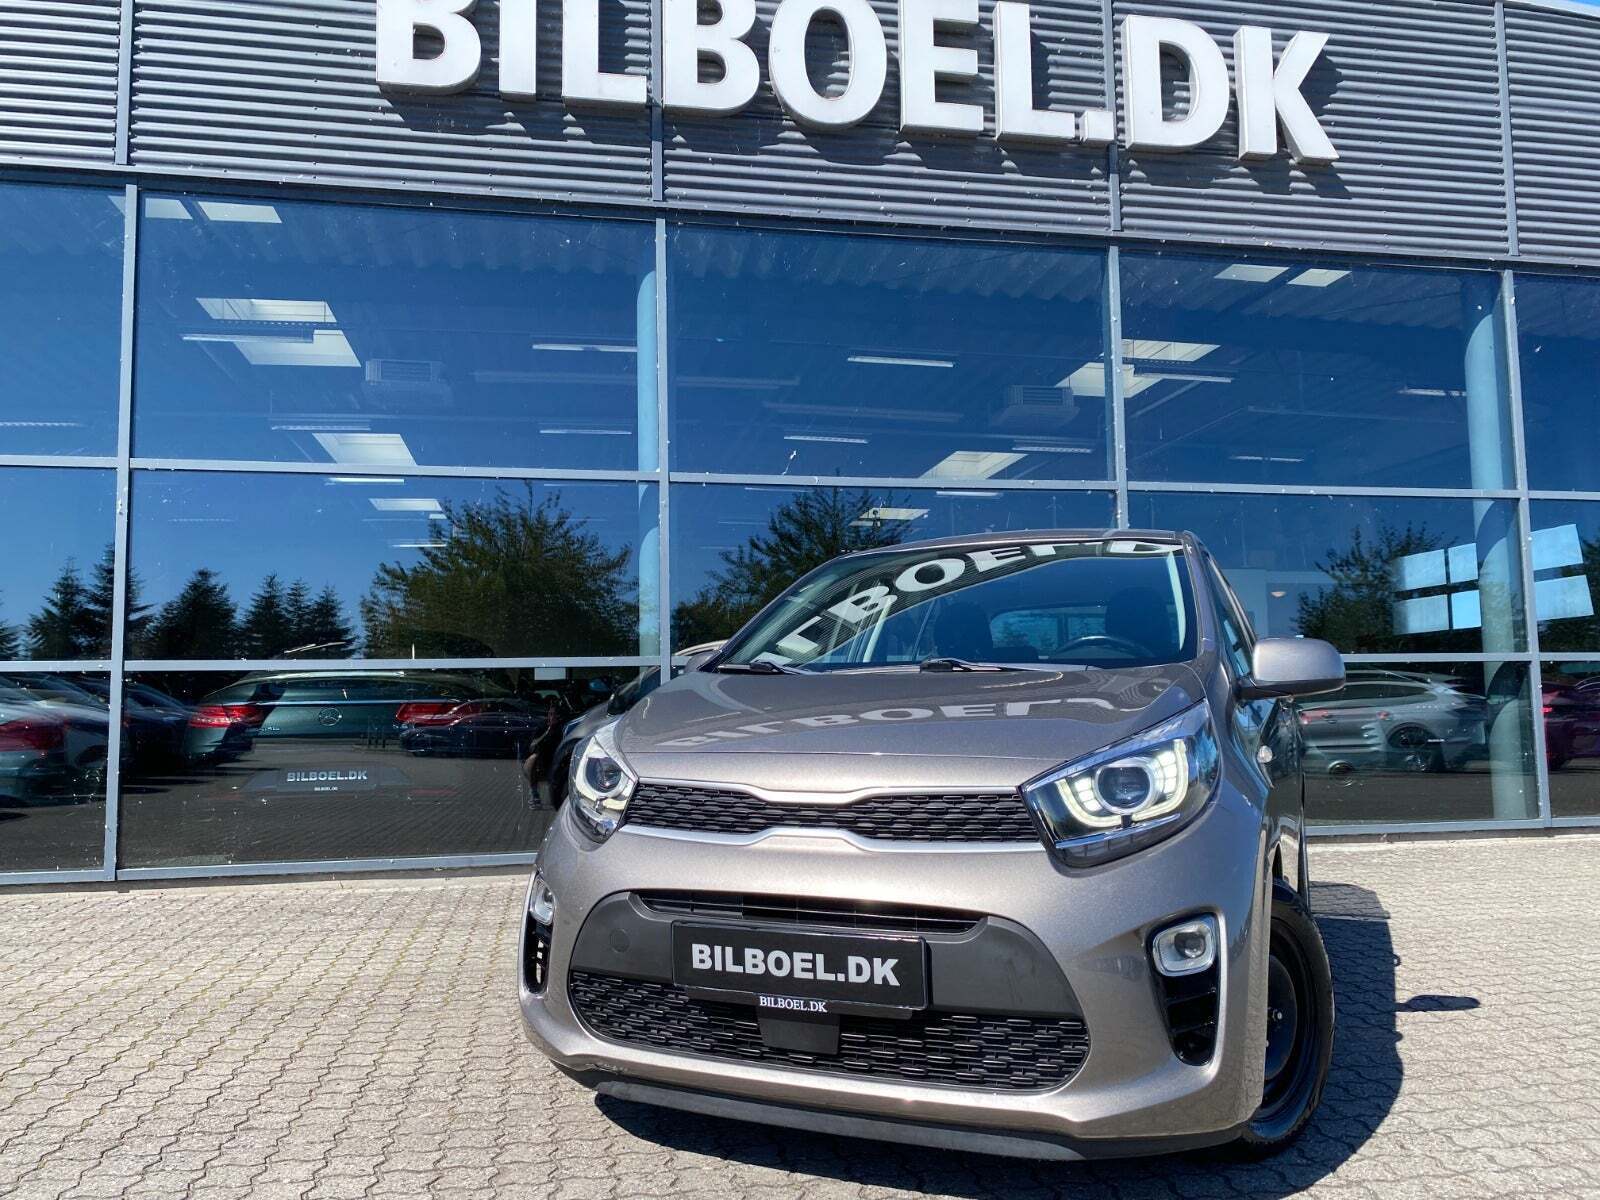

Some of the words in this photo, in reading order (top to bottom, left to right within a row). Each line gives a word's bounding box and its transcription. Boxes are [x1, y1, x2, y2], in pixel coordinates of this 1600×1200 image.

[375, 0, 1339, 163] BILBOEL.DK
[286, 770, 368, 782] BILBOEL.DK
[691, 943, 900, 986] BILBOEL.DK
[759, 995, 828, 1013] BILBOEL.DK
